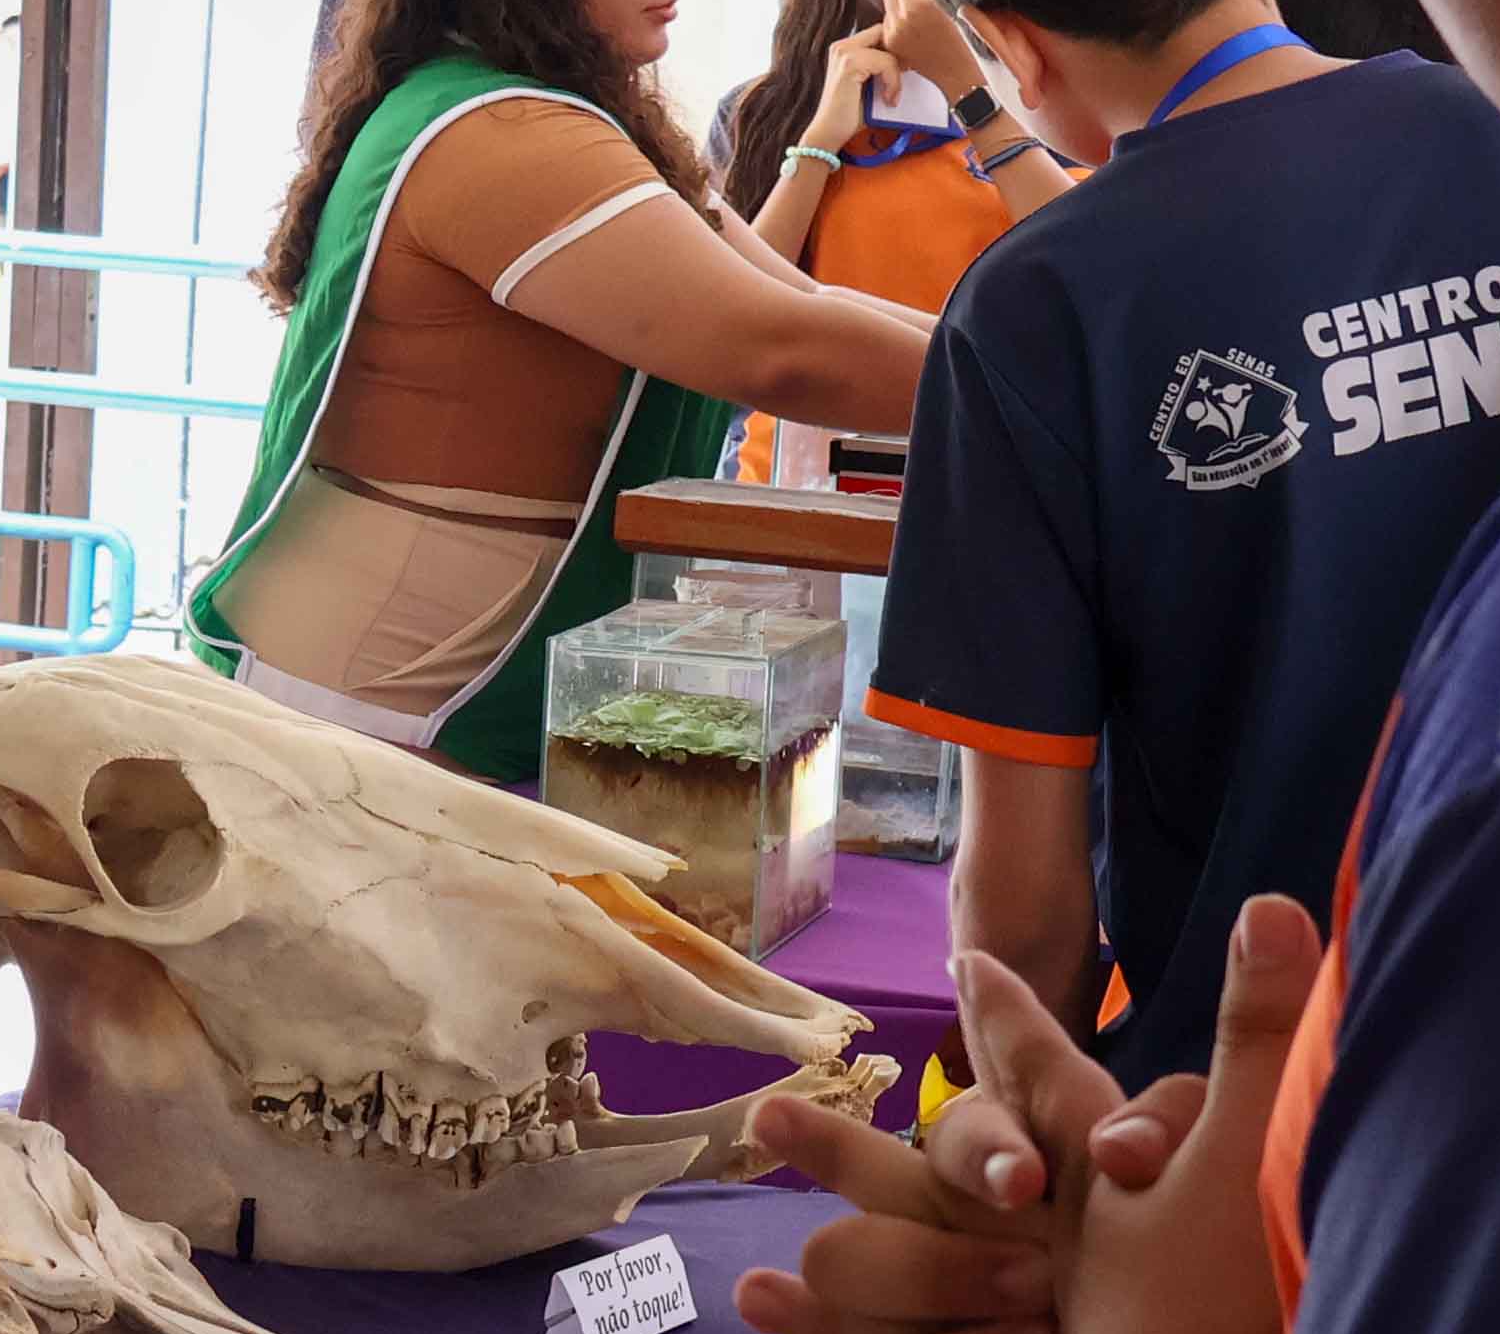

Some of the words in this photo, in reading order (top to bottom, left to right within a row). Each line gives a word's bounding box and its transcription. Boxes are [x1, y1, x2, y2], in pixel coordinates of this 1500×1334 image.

[1226, 347, 1277, 378] SENAS
[1149, 382, 1180, 442] CENTRO
[1175, 352, 1195, 376] ED.
[578, 1269, 613, 1297] Por
[613, 1251, 672, 1299] favor,
[632, 1282, 686, 1330] toque!
